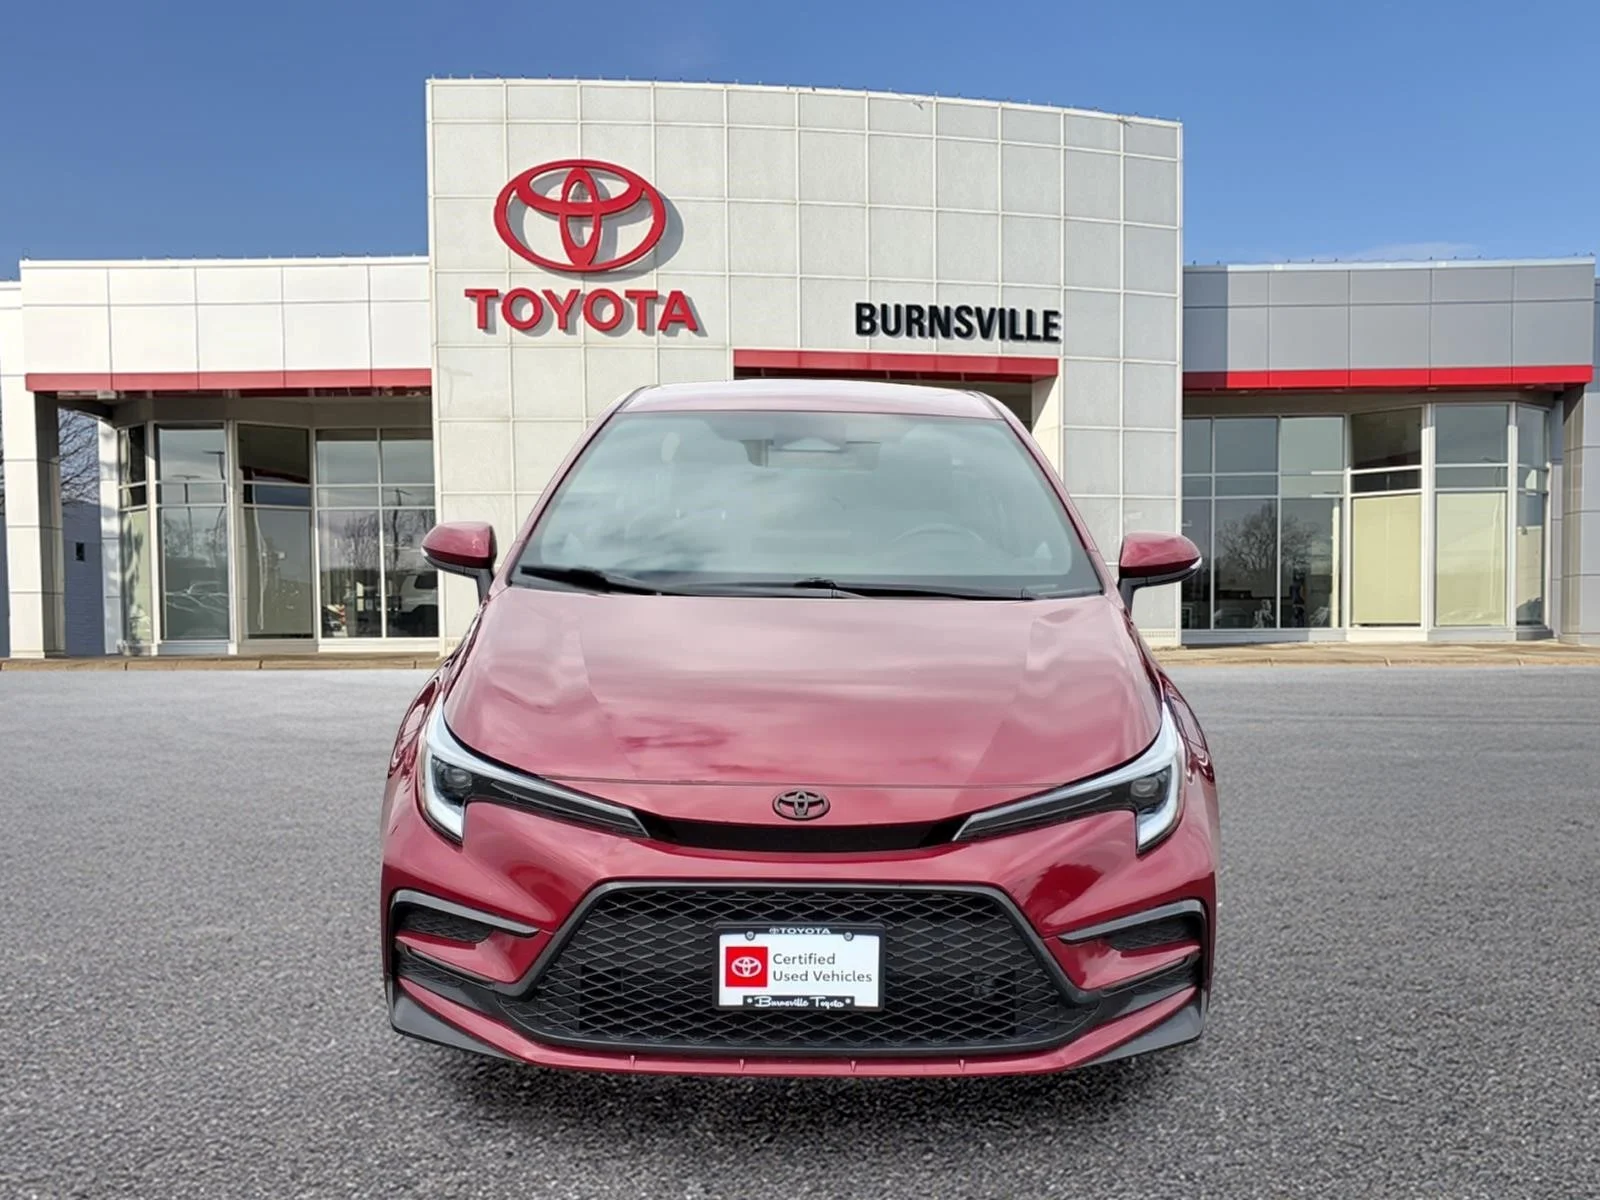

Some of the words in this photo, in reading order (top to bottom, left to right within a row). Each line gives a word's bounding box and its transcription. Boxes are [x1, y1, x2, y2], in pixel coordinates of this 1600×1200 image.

[464, 287, 699, 332] TOYOTA
[855, 302, 1062, 342] BURNSVILLE
[779, 927, 831, 935] TOYOTA
[772, 953, 836, 965] Certified
[772, 971, 809, 982] Used
[812, 971, 873, 982] Vehicles
[754, 996, 809, 1008] Burnsville
[810, 996, 844, 1009] Toyota
